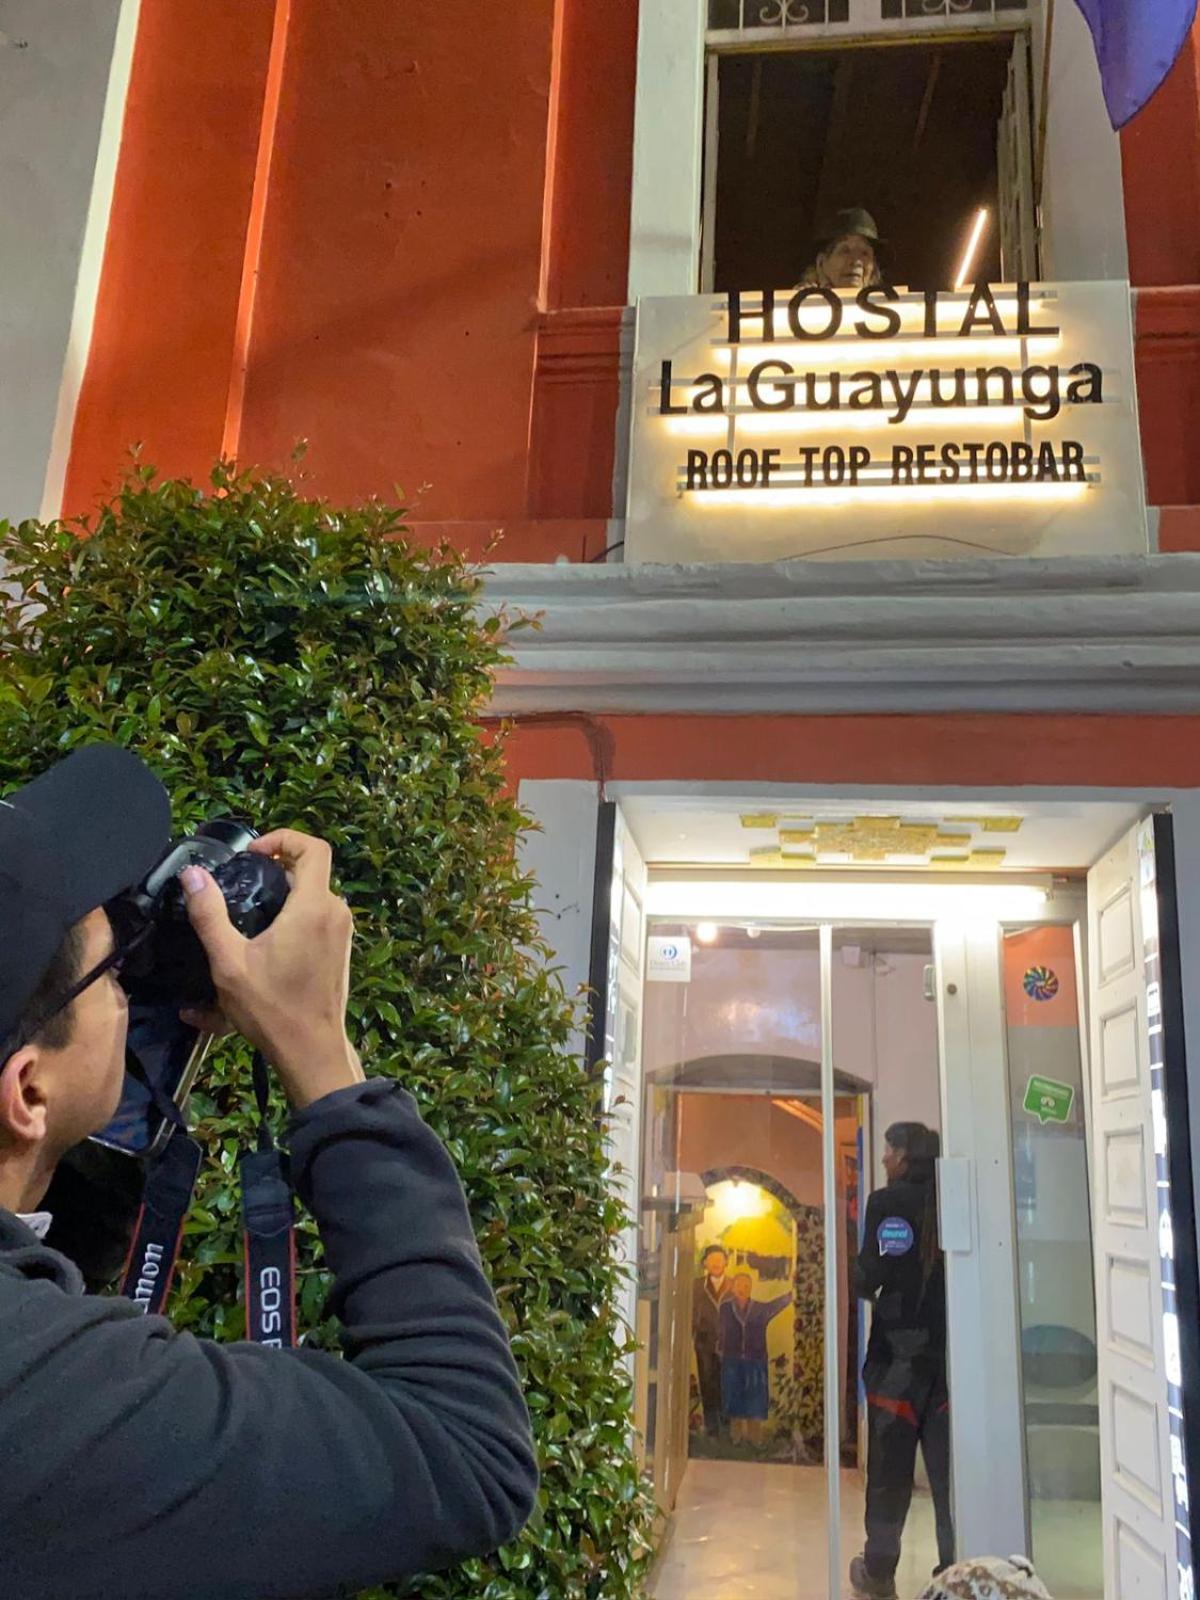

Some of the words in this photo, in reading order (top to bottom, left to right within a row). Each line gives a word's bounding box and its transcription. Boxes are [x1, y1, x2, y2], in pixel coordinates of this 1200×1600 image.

[728, 282, 1060, 343] HOSTAL
[660, 360, 724, 416] La
[747, 359, 1103, 424] Guayunga
[686, 448, 780, 490] ROOF
[799, 446, 870, 487] TOP
[891, 441, 1087, 485] RESTOBAR
[260, 1267, 281, 1333] EOS
